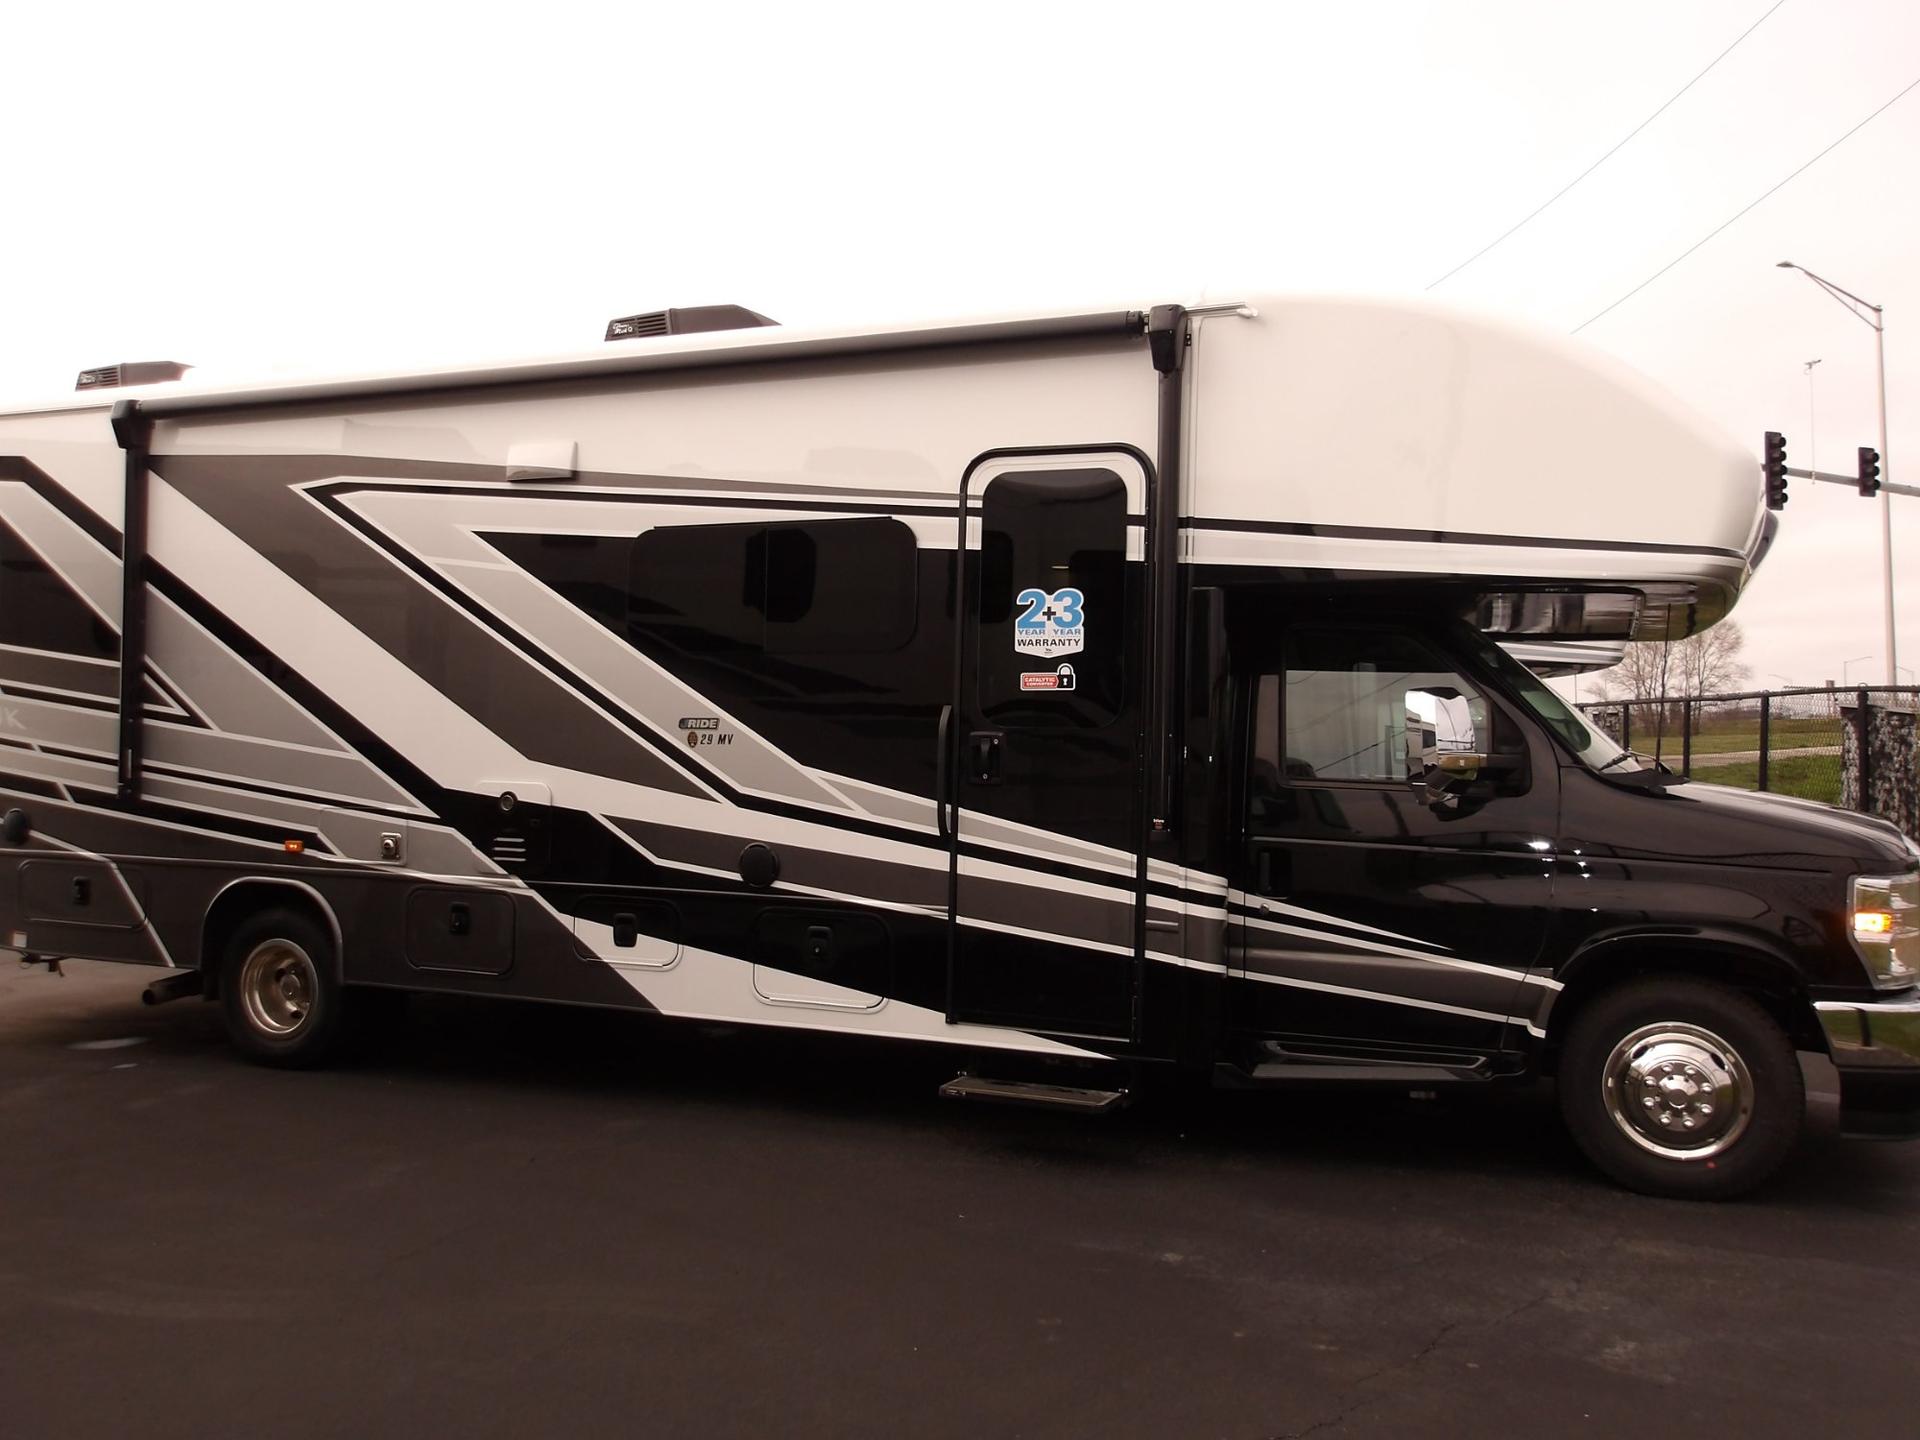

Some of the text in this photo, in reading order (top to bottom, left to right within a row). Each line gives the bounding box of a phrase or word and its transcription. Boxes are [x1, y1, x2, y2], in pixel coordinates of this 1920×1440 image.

[1017, 638, 1081, 647] WARRANTY
[700, 733, 734, 745] 29 MV
